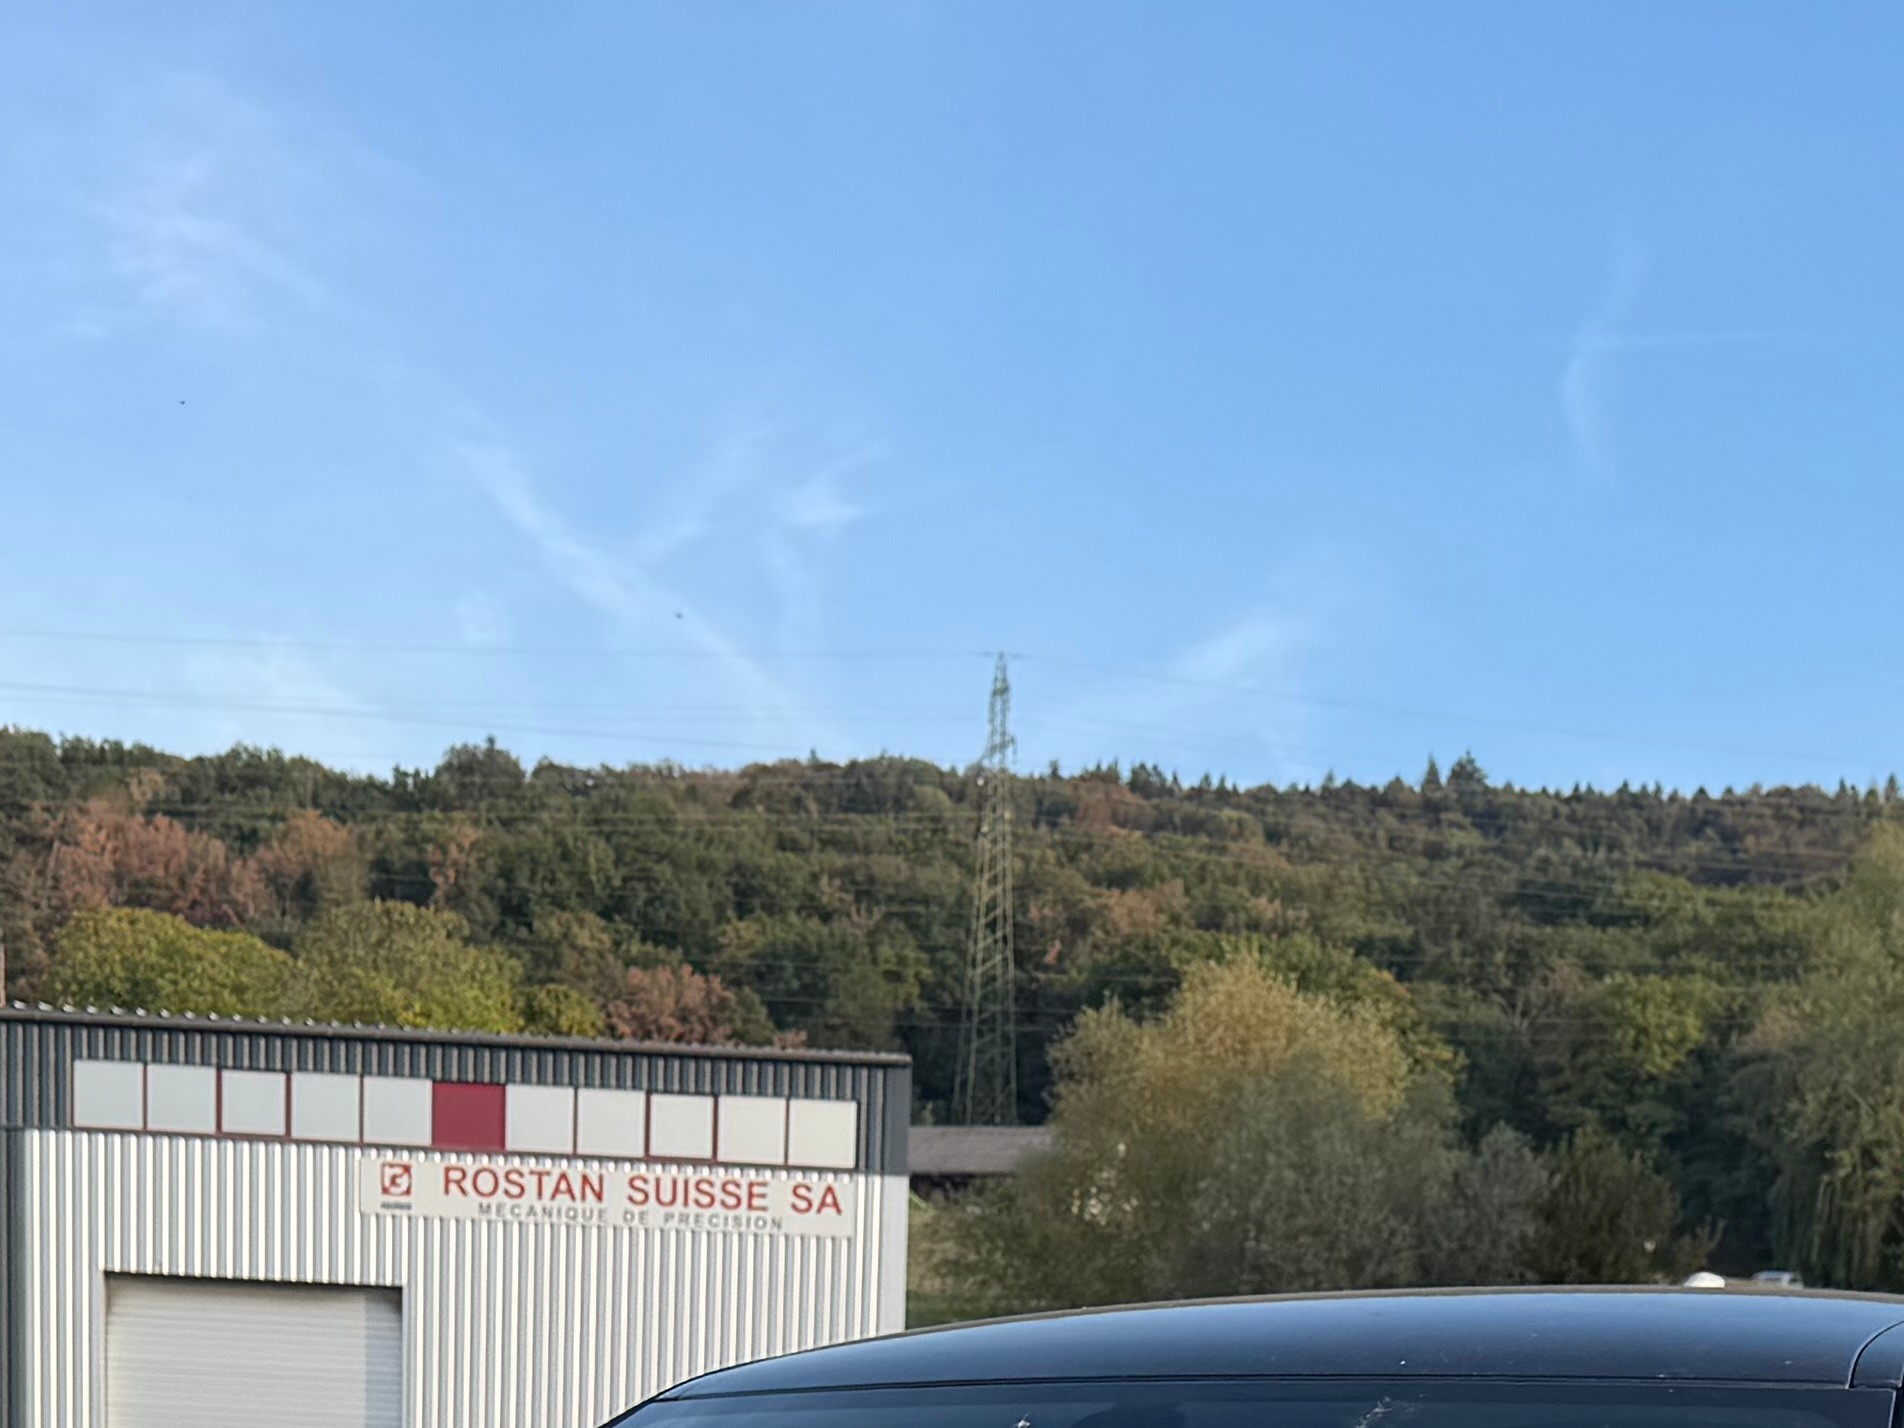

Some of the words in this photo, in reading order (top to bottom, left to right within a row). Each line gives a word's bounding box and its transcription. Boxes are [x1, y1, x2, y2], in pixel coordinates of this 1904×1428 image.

[443, 1165, 605, 1204] ROSTAN
[627, 1174, 770, 1213] SUISSE
[790, 1183, 843, 1216] SA
[622, 1209, 648, 1225] DE
